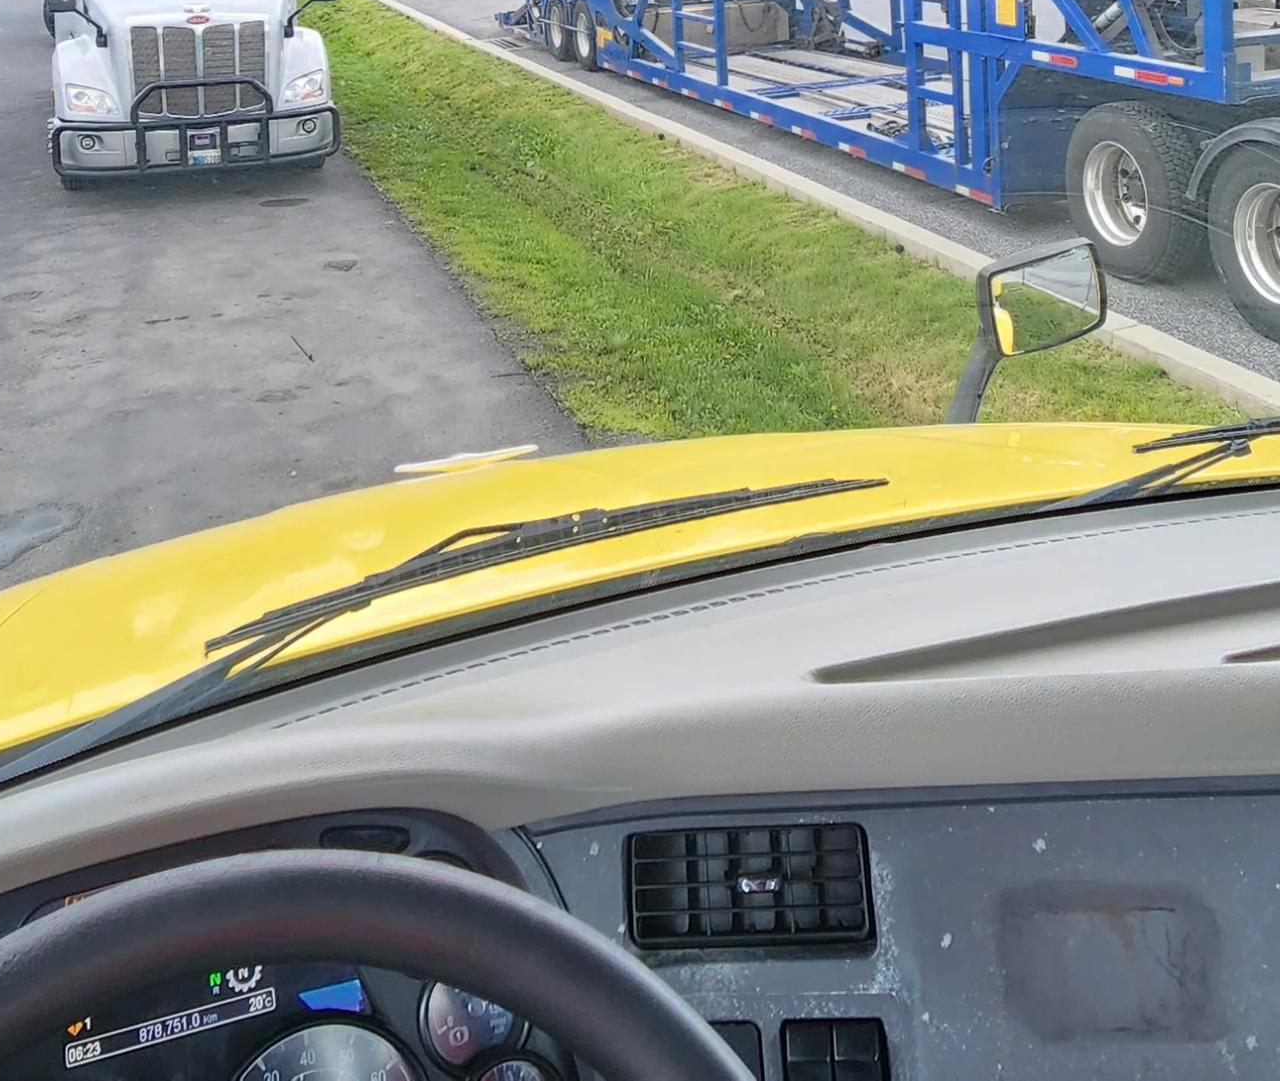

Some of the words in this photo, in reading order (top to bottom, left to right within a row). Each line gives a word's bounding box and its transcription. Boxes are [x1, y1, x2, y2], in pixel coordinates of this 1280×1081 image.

[210, 972, 221, 987] N
[84, 1016, 91, 1030] 1
[68, 1041, 102, 1063] 06:23
